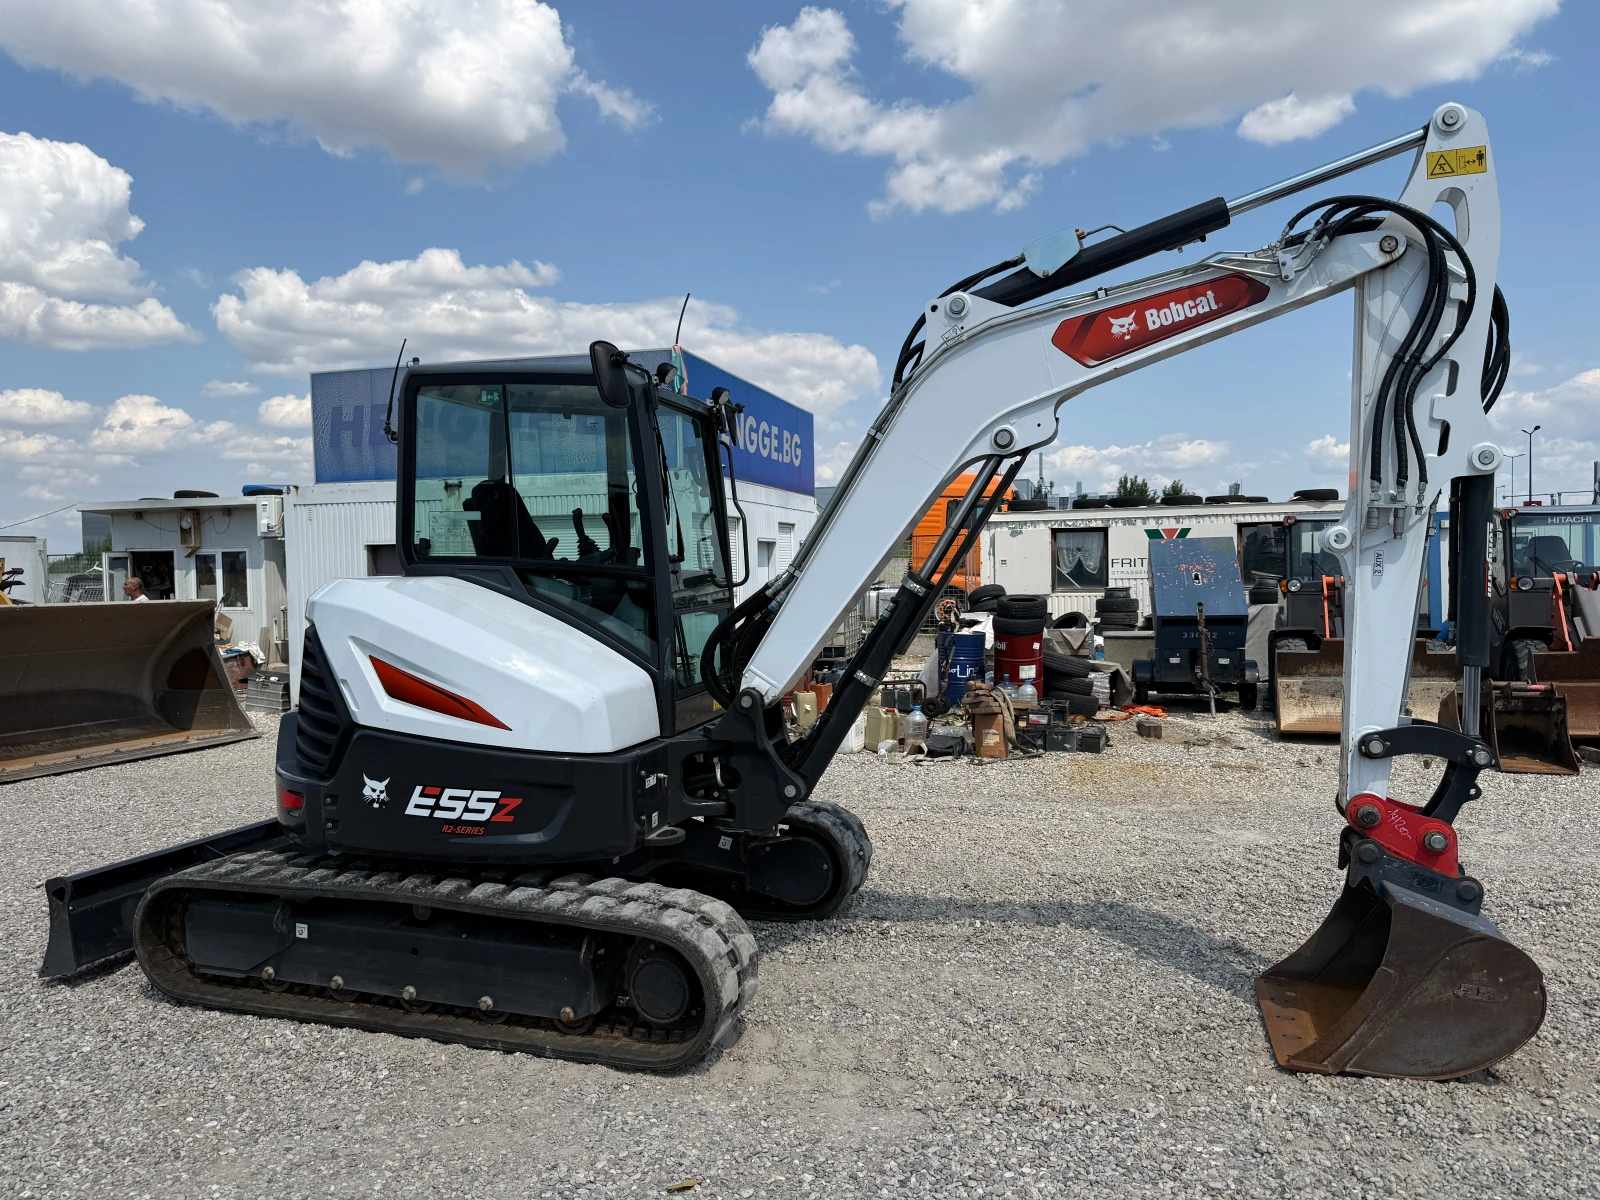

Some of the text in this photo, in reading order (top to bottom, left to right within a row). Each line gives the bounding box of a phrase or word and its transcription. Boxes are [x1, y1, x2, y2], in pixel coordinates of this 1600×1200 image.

[1145, 290, 1217, 330] Bobcat
[1548, 516, 1592, 524] HITACHI
[1111, 557, 1148, 568] FRIT
[1375, 552, 1383, 568] AUX
[441, 824, 485, 835] R2-SERIES
